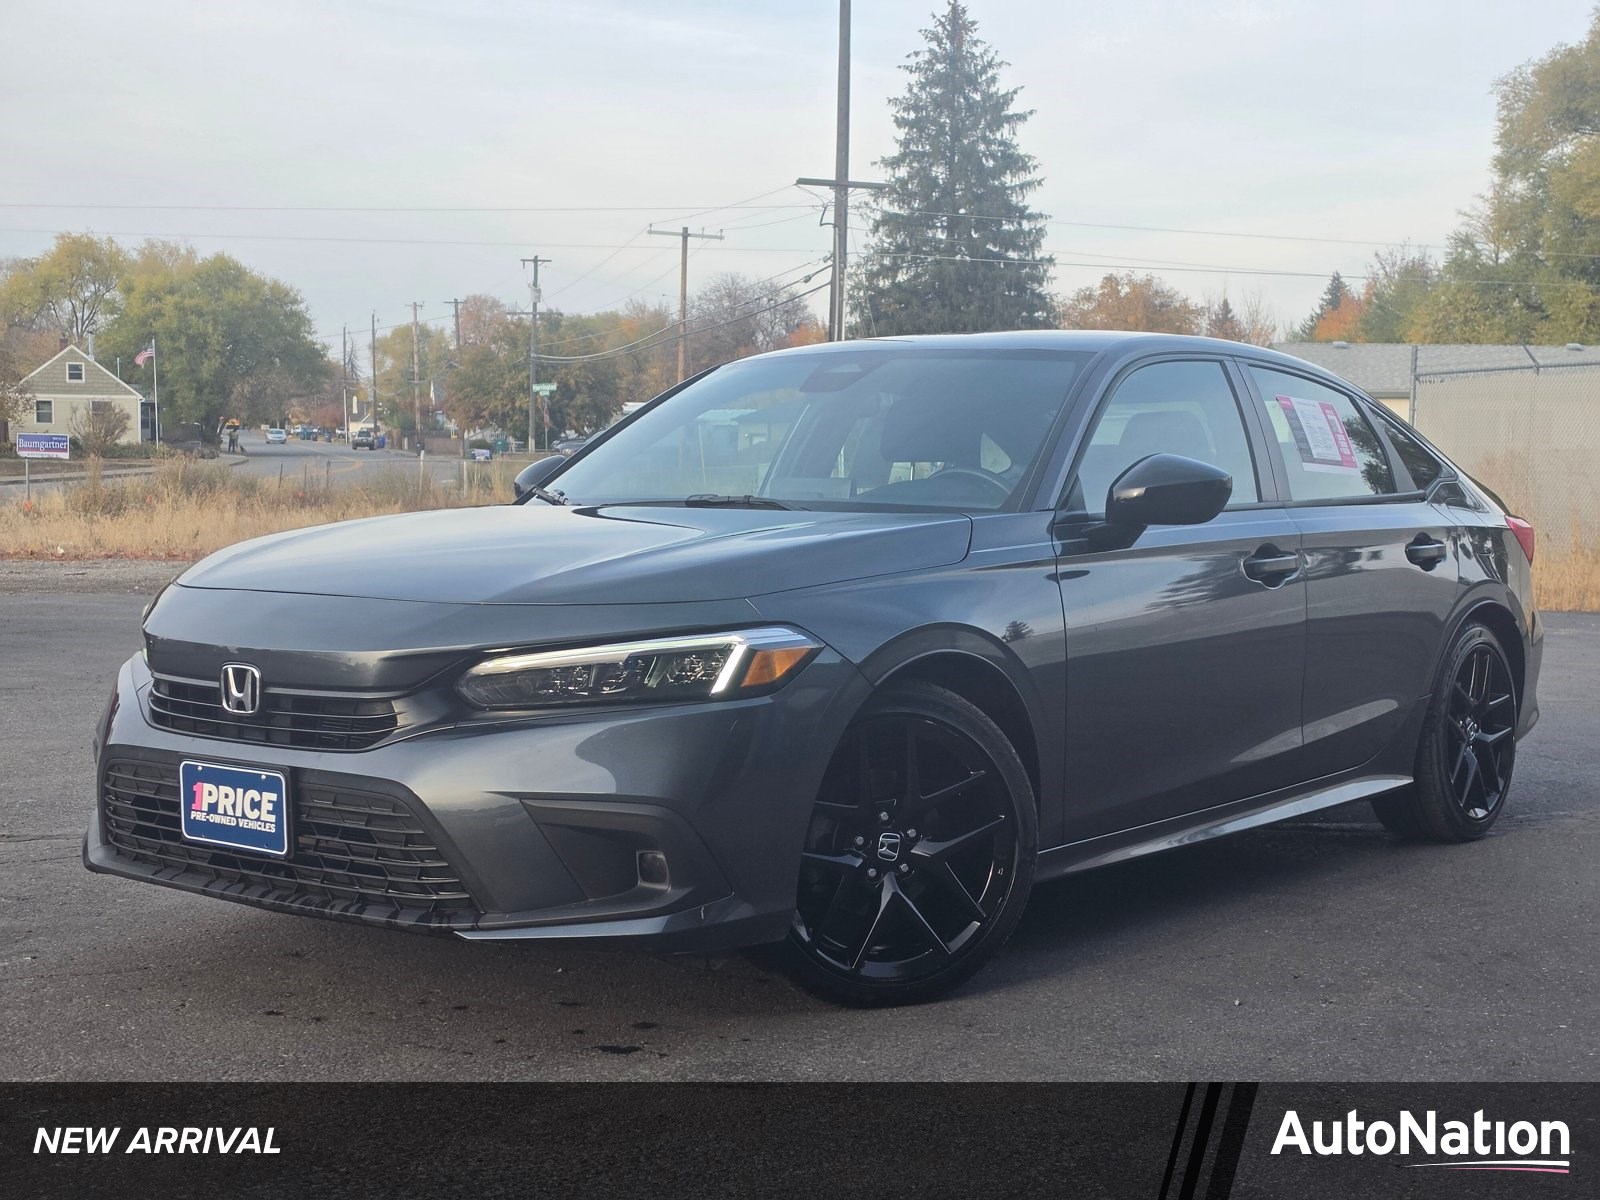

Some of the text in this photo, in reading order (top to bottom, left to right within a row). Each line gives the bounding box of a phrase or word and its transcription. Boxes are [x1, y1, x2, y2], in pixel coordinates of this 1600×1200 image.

[19, 438, 67, 451] Baumgartner
[191, 782, 278, 822] 1PRICE
[190, 810, 276, 833] PRE-OWNED VEHICLES
